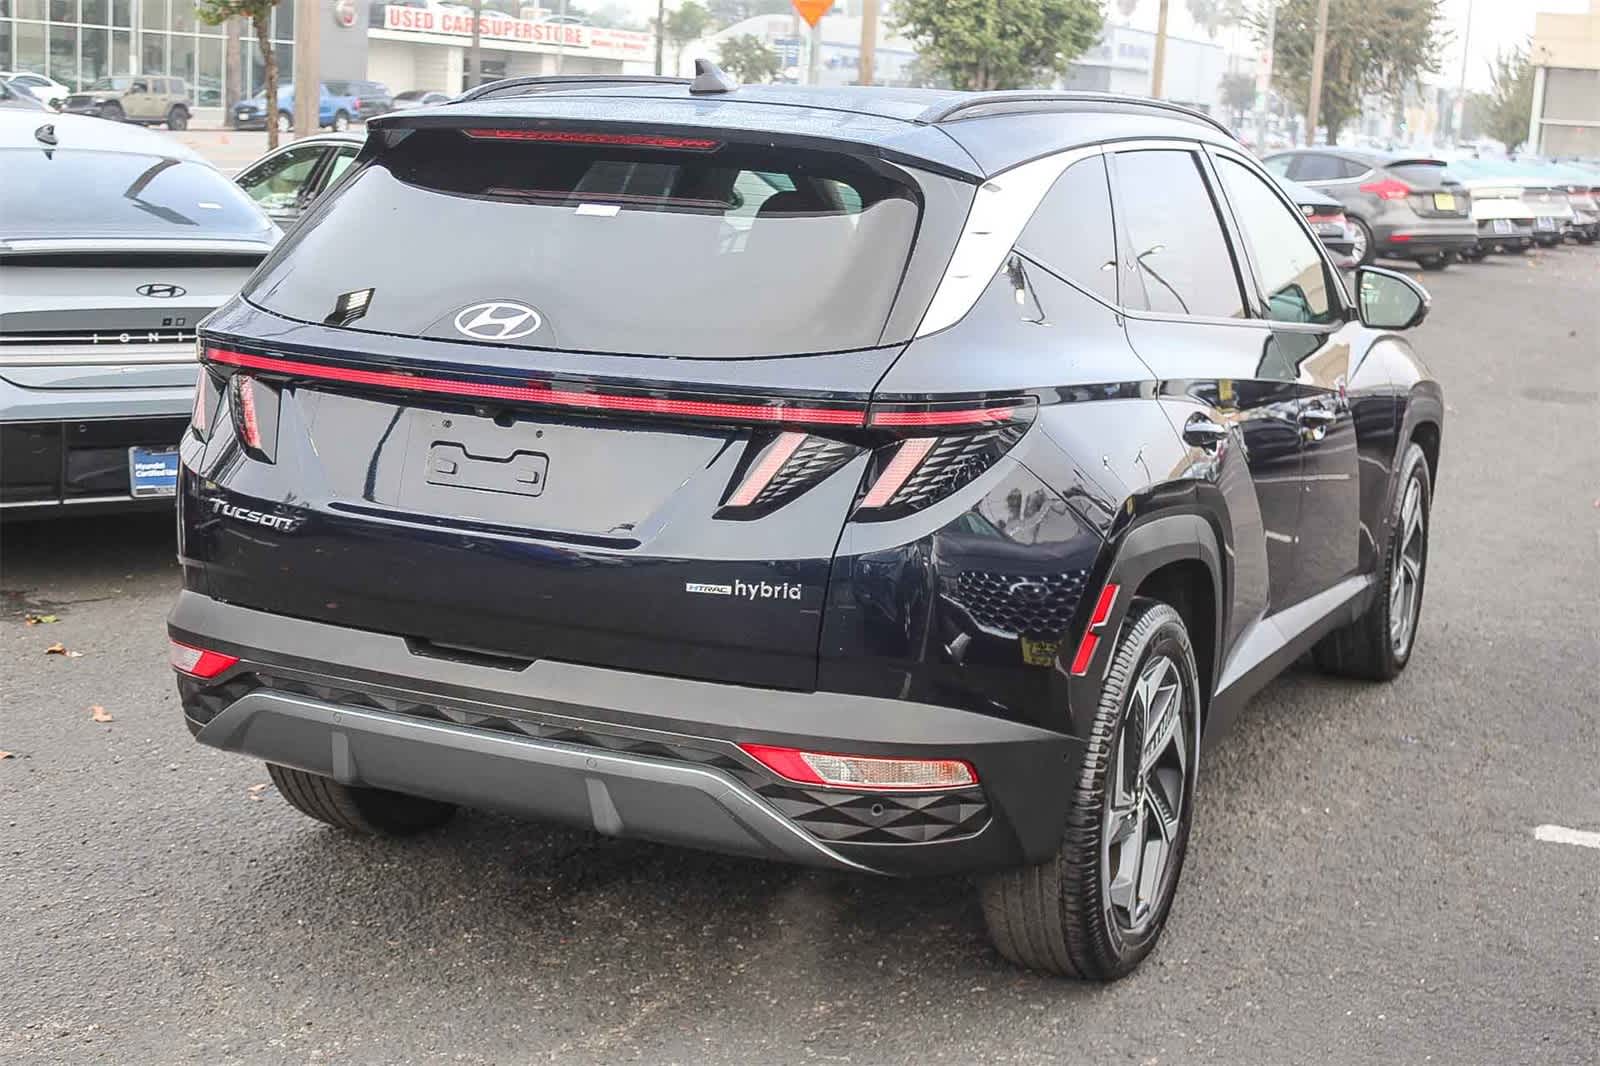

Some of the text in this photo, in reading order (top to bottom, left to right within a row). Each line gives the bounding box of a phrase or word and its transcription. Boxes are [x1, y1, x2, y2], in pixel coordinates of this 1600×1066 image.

[390, 7, 433, 29] USED
[441, 14, 475, 33] CAR
[480, 17, 582, 44] SUPERSTORE
[734, 579, 802, 601] hybrid
